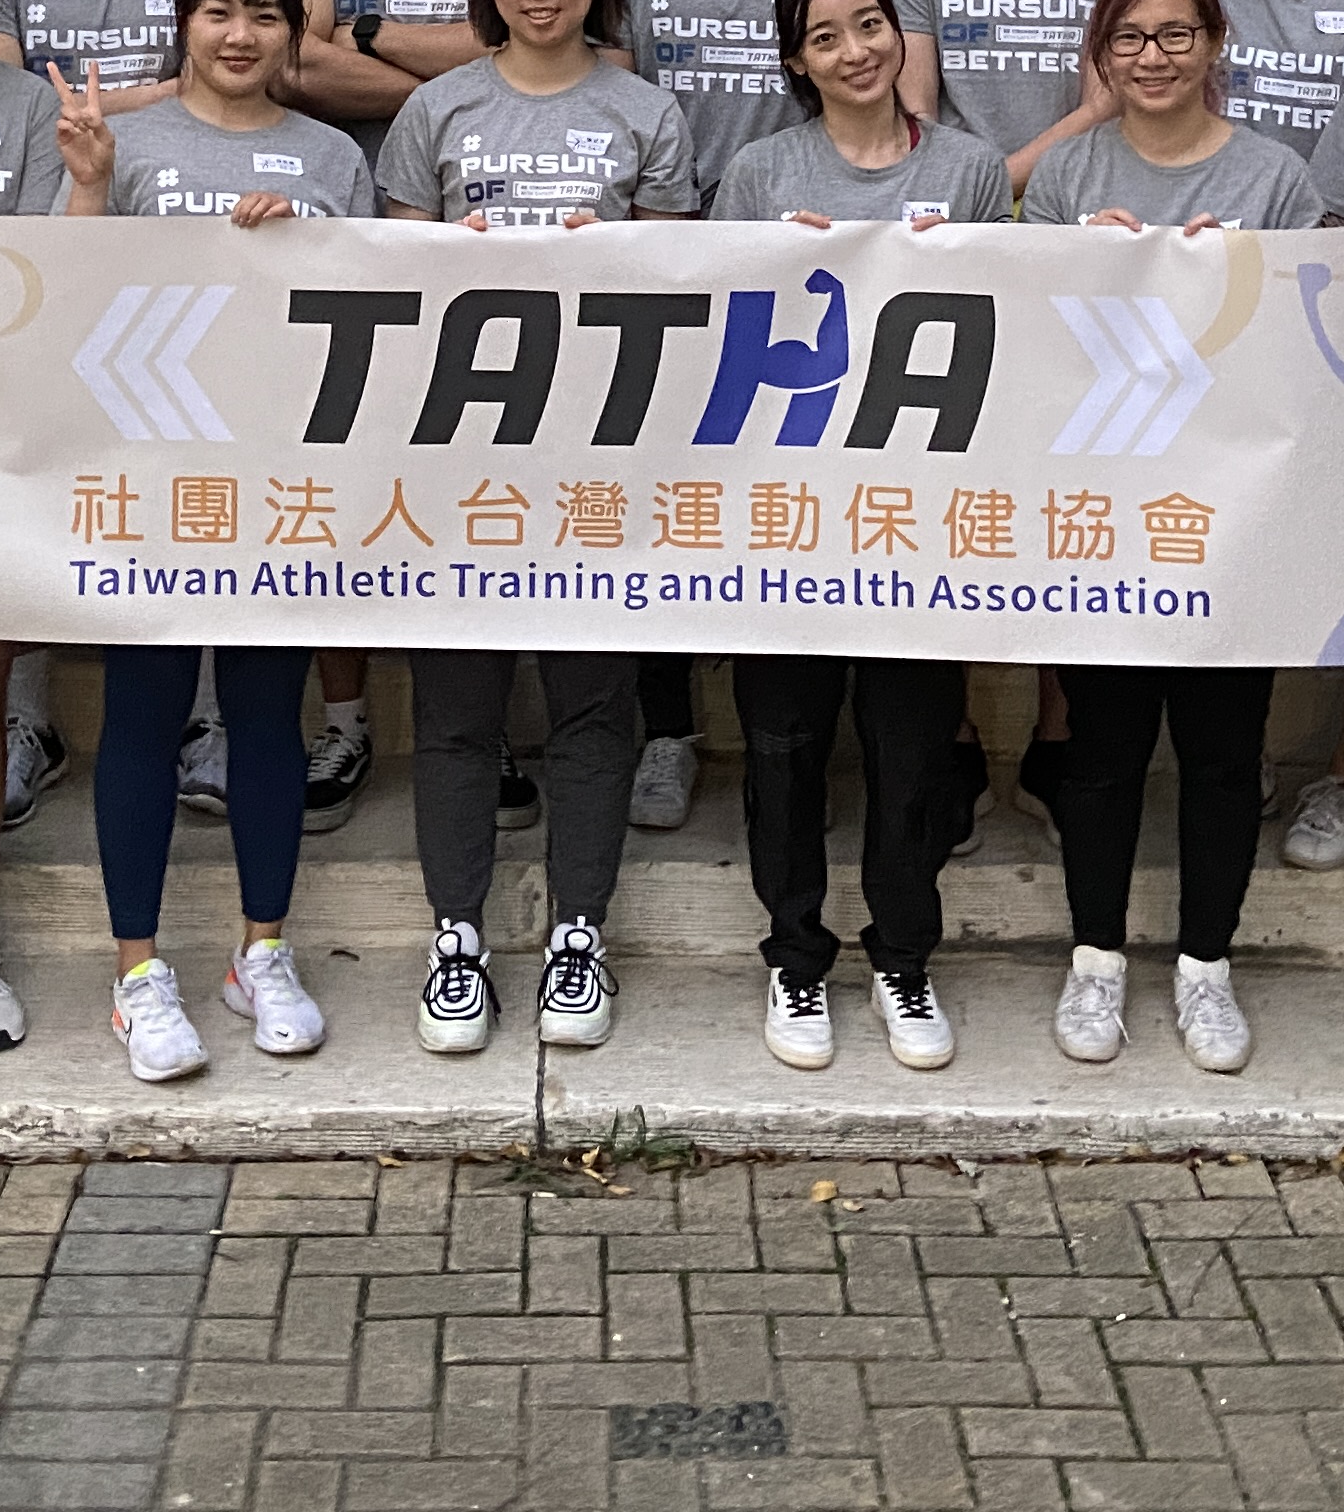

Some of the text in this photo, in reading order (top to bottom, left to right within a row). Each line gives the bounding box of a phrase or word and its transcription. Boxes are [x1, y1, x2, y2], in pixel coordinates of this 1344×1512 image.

[26, 26, 177, 50] PURSUIT
[652, 17, 775, 40] PURSU
[943, 50, 1080, 73] BETTER
[657, 69, 786, 95] BETTER
[1223, 97, 1334, 130] ETTER
[460, 153, 619, 178] PURSUIT
[465, 180, 505, 203] OF
[560, 185, 595, 196] TATHA
[288, 268, 996, 455] TATHA
[70, 473, 1216, 566] 社團法人台灣運動保健協會
[70, 558, 1211, 618] Taiwan Athletic Training and Health Association
